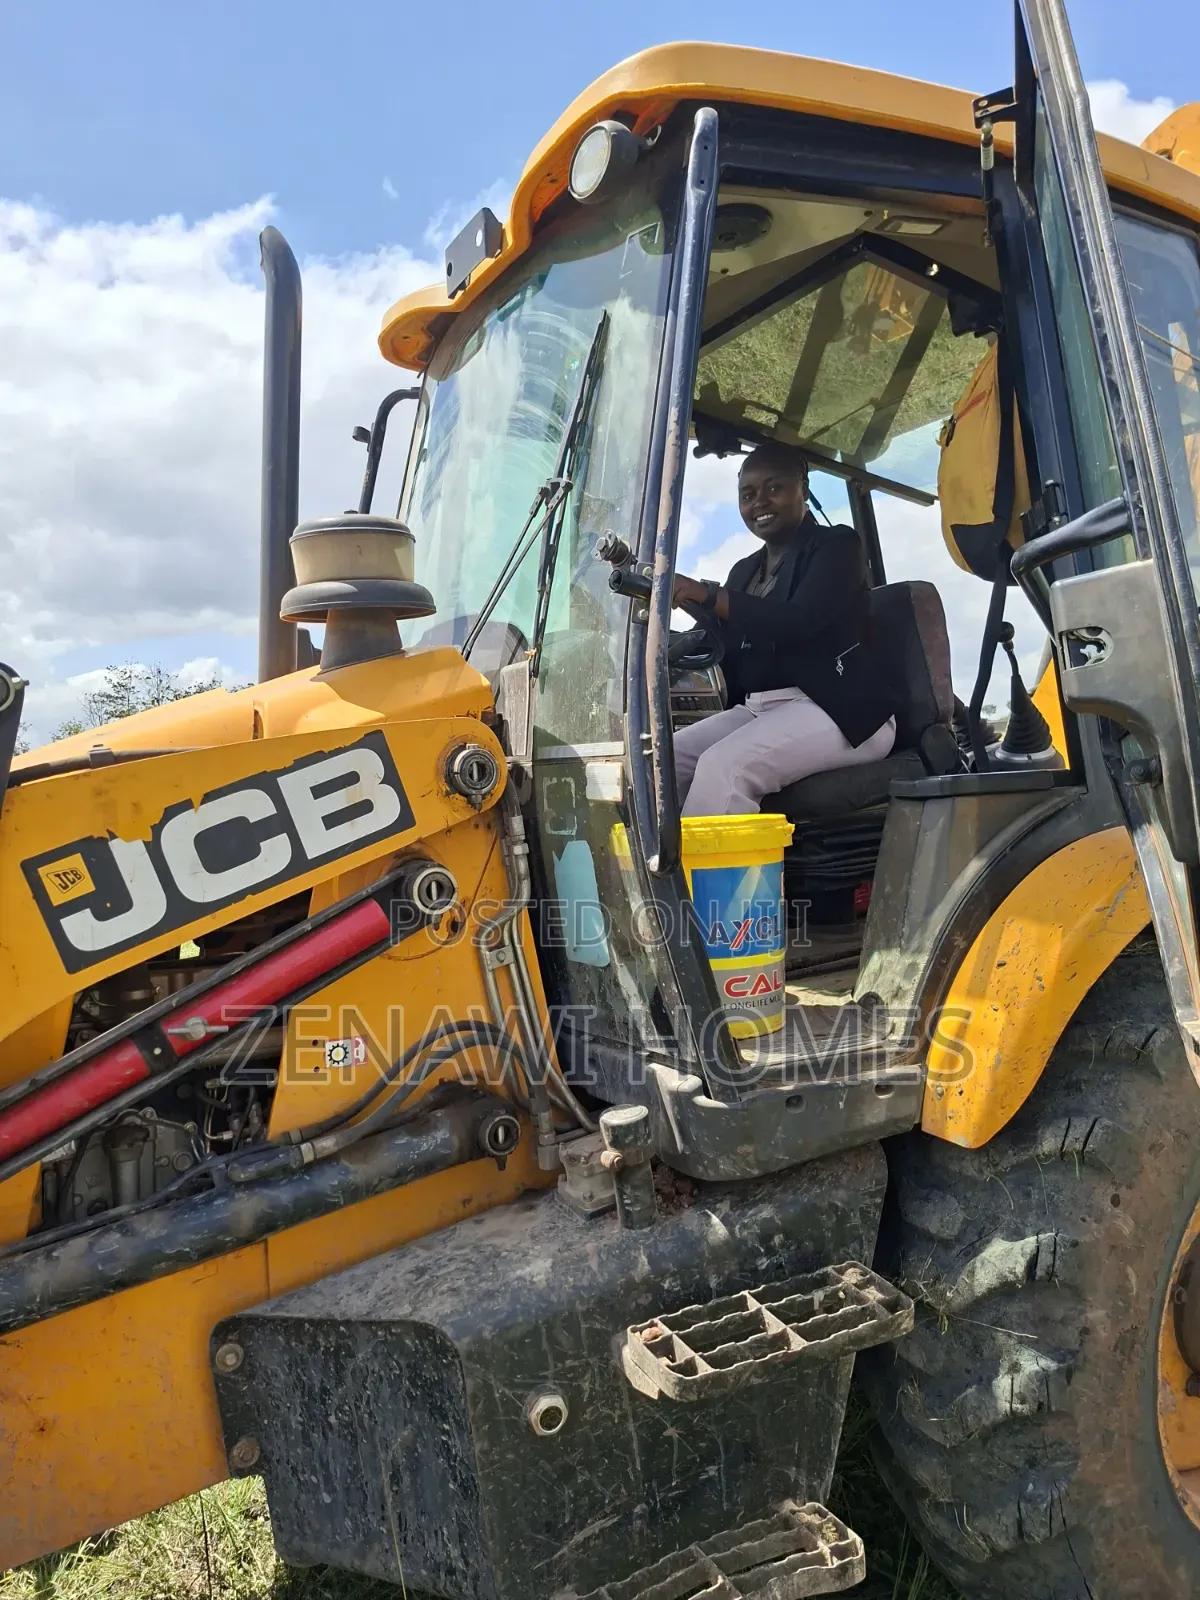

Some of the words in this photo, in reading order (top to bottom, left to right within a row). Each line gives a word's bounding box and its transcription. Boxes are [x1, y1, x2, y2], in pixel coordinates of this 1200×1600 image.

[60, 748, 401, 952] JCB
[53, 869, 83, 891] JCB
[723, 968, 785, 999] CAL
